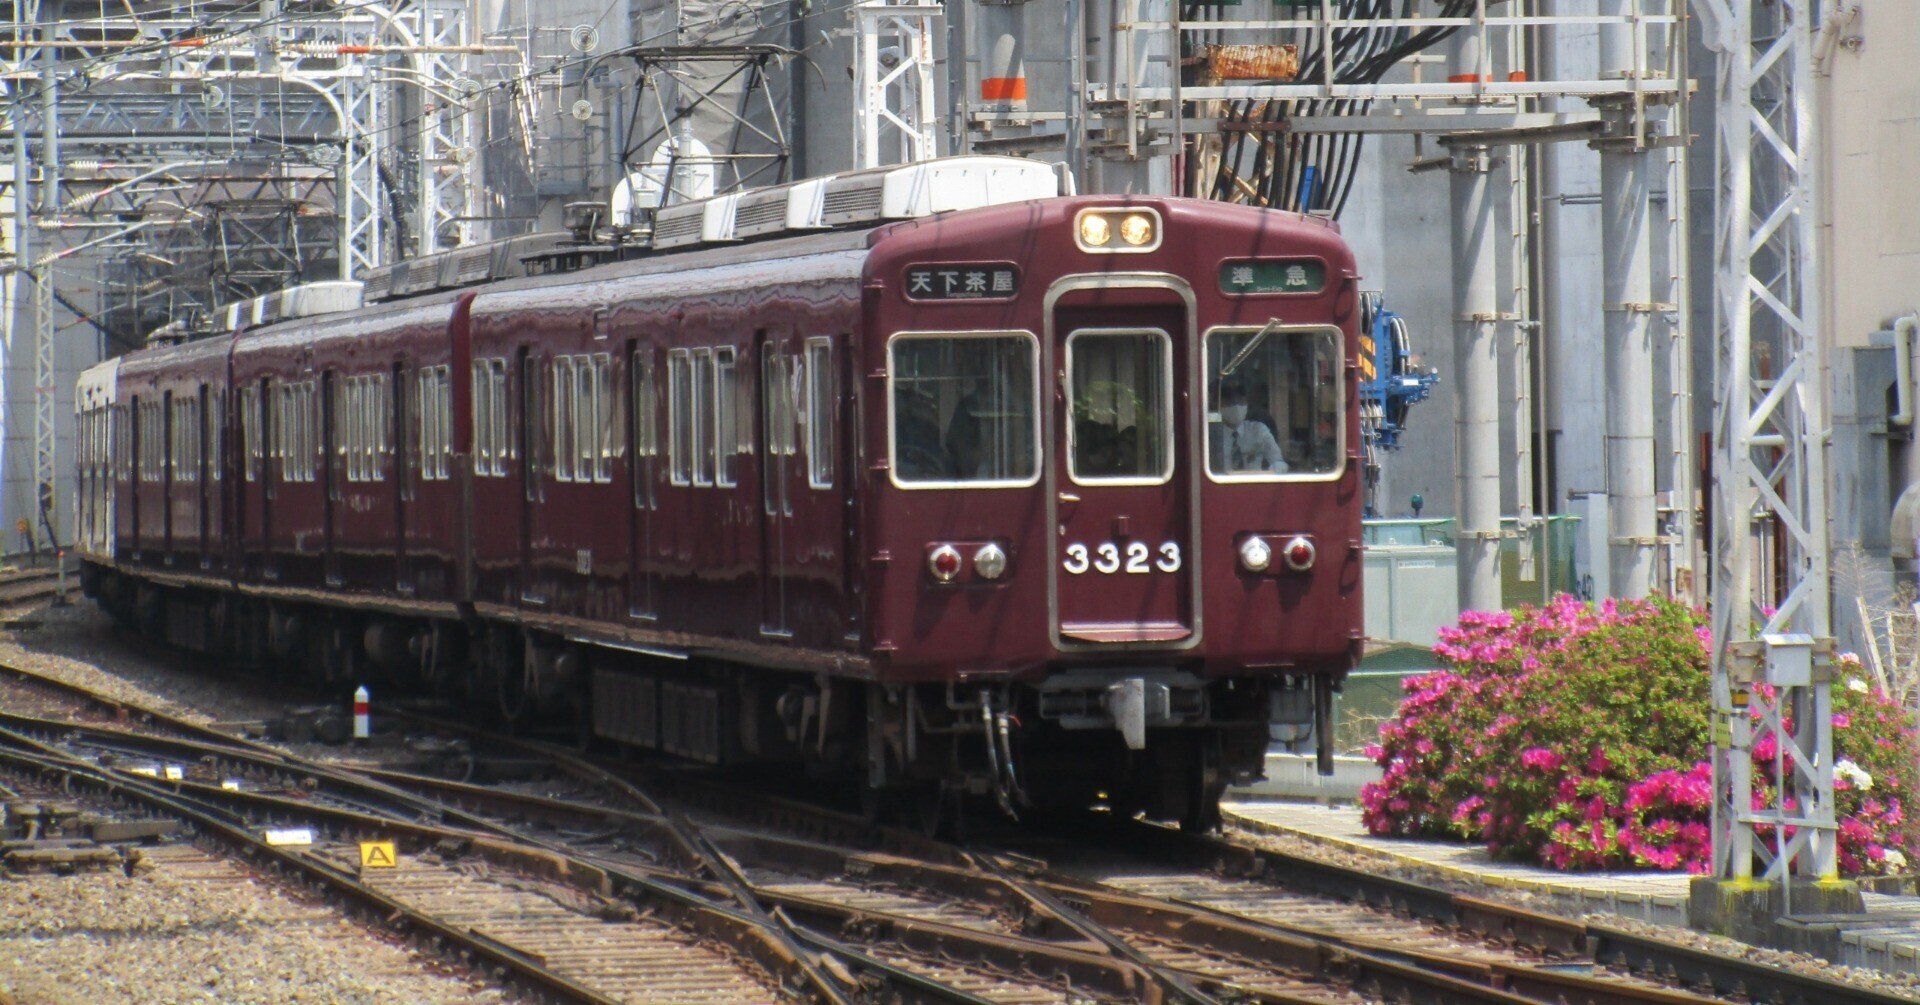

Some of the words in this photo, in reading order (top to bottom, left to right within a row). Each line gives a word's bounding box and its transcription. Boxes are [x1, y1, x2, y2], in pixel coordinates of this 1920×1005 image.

[911, 271, 1013, 293] 天下茶屋
[1232, 265, 1307, 287] 準急
[1063, 542, 1181, 574] 3323
[366, 846, 392, 864] A
